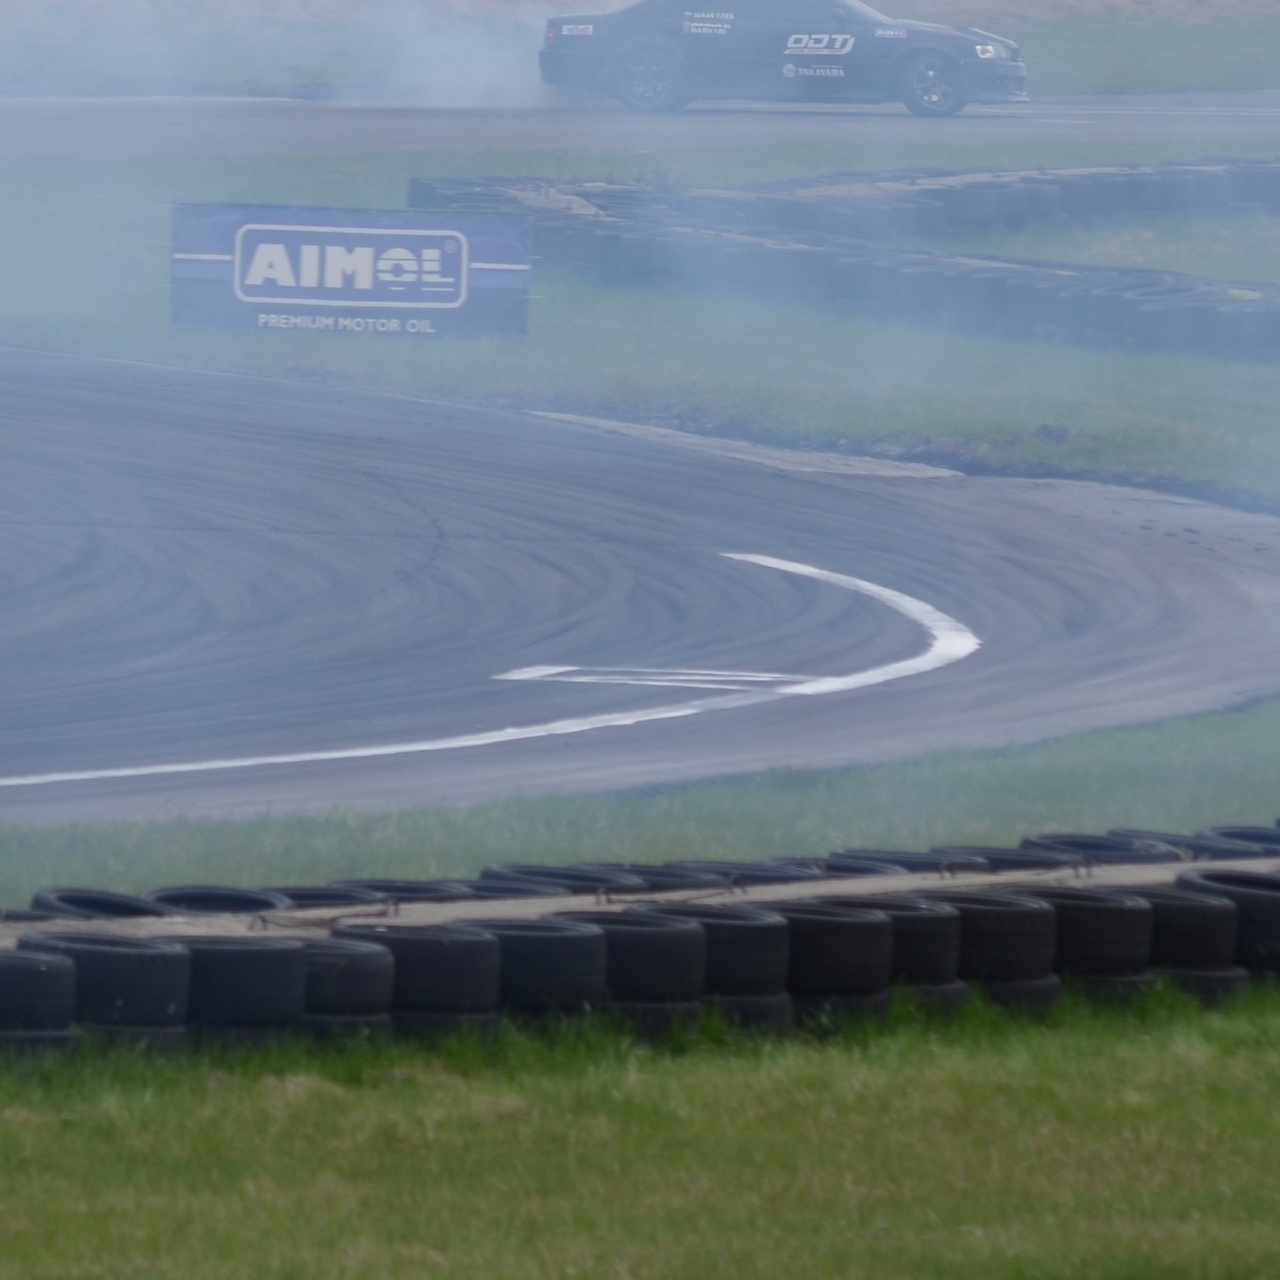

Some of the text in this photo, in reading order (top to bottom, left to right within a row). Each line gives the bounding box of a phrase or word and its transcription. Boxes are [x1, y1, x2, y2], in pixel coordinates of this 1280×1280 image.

[797, 68, 845, 78] TAKAYAMA
[244, 243, 456, 291] AIMOL
[257, 313, 436, 334] PREMIUM MOTOR OIL
